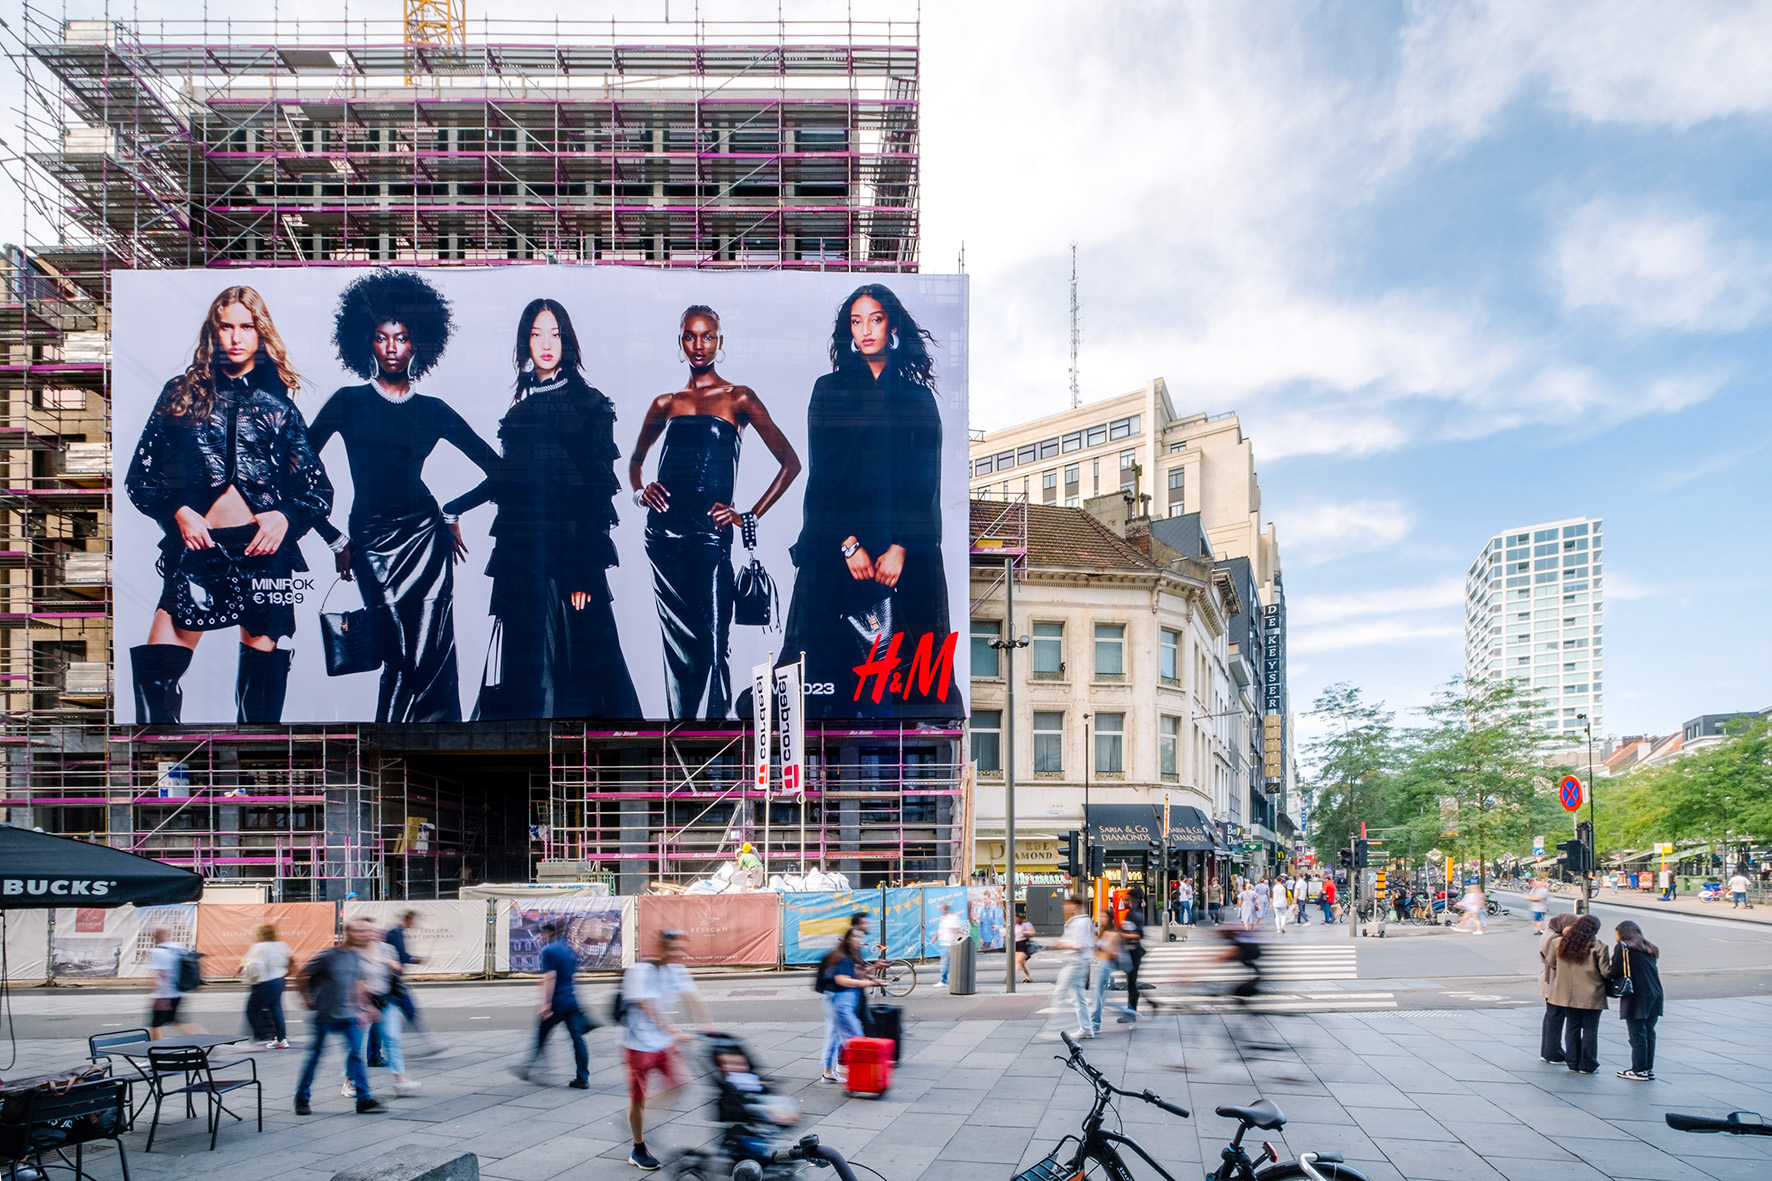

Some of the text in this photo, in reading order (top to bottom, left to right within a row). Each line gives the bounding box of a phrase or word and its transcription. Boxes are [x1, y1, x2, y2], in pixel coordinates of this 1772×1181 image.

[252, 578, 314, 590] MINIROK
[252, 592, 304, 606] € 19,99
[852, 631, 958, 704] H&M
[1267, 605, 1278, 776] DE KEYSER HOTEL
[1125, 825, 1135, 834] &
[989, 842, 1059, 860] DAMONDS
[1026, 842, 1058, 850] EDEN
